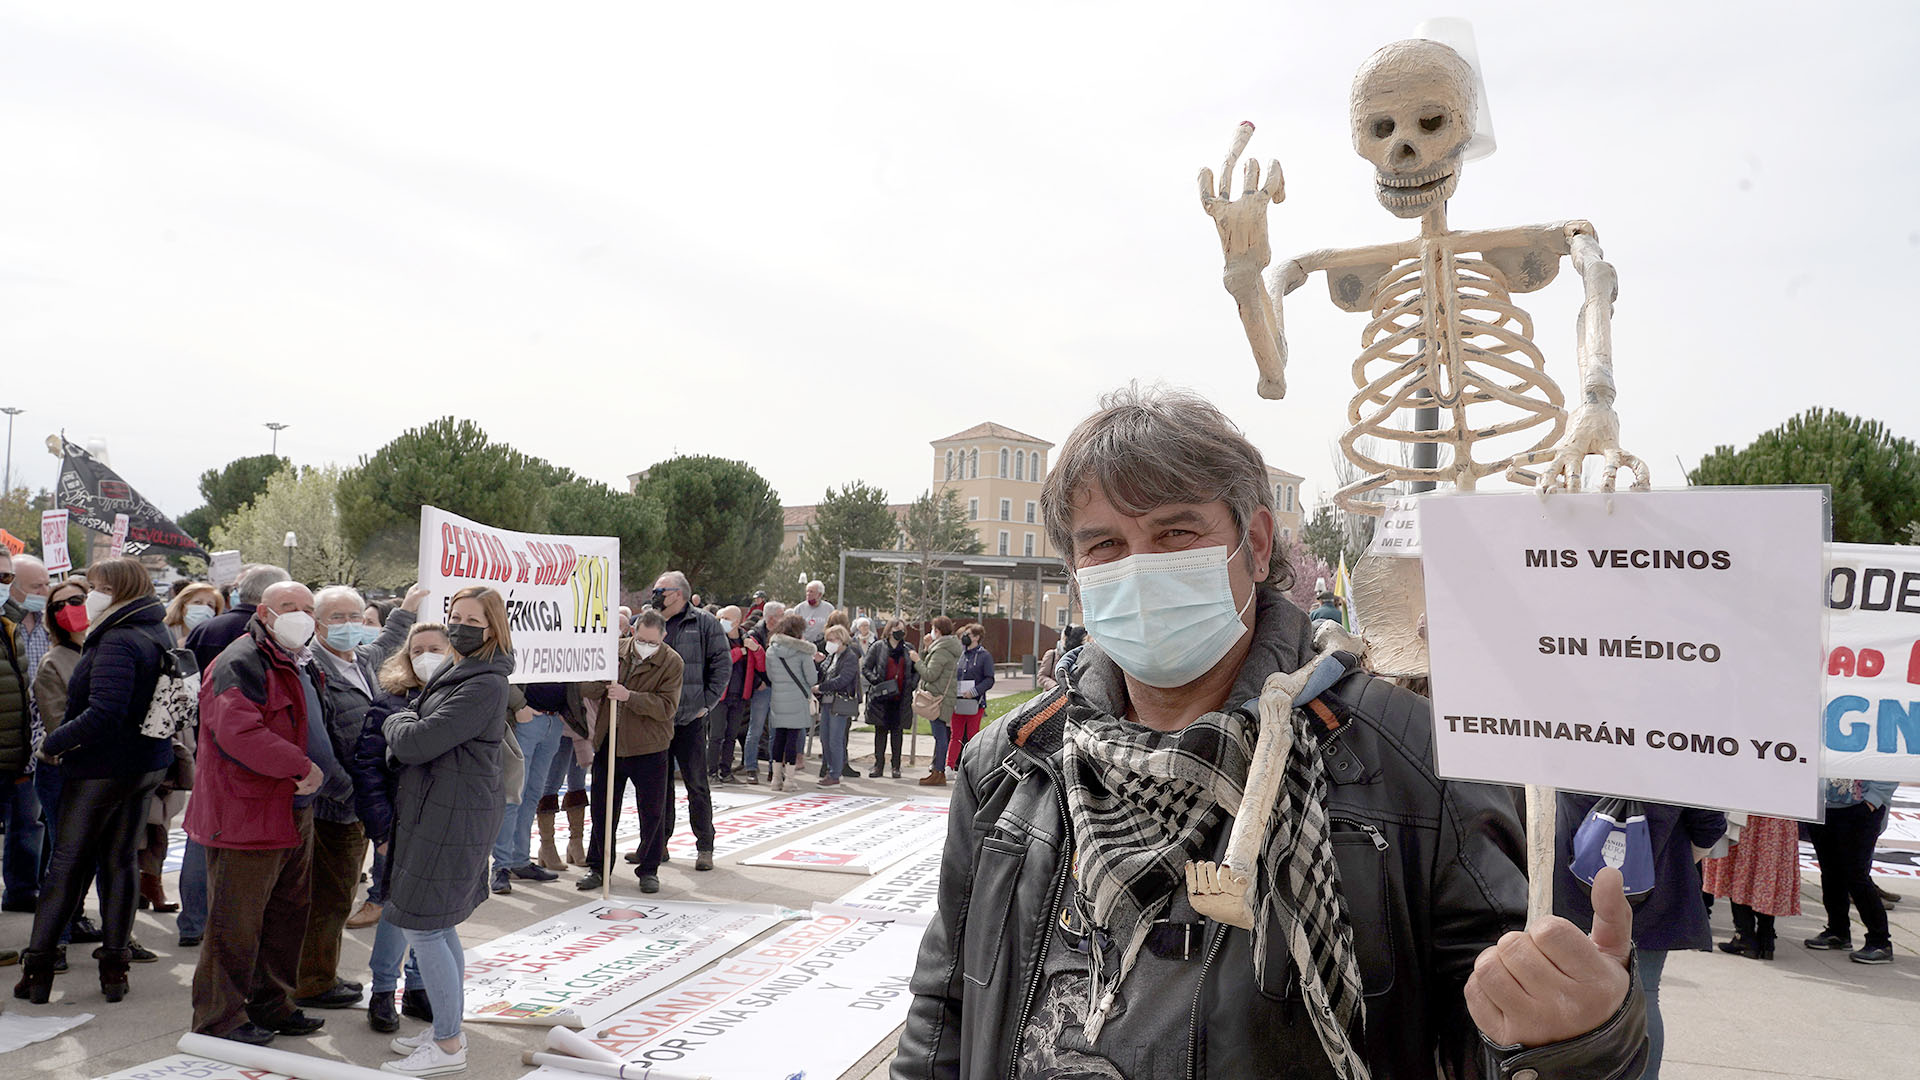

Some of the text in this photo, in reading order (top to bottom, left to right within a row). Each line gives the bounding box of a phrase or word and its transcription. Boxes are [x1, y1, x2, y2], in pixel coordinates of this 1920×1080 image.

[78, 516, 115, 534] #SPAN
[1381, 538, 1403, 547] ME
[440, 522, 577, 586] CENTRO DE SALUD
[1525, 549, 1731, 569] MIS VECINOS
[522, 648, 530, 674] Y
[1538, 635, 1721, 664] SIN MÉDICO
[1821, 646, 1885, 677] AD
[1444, 714, 1808, 763] TERMINARÁN COMO YO.
[864, 853, 942, 901] EN DEFENS
[507, 962, 559, 974] LA
[539, 924, 639, 962] SANIDAD
[697, 977, 745, 987] Y
[723, 958, 787, 977] EL
[755, 914, 852, 959] BIERZO
[529, 990, 582, 1003] LA
[565, 938, 688, 989] CISTÉRNIGA
[571, 996, 603, 1007] EN
[592, 965, 653, 997] DEFENSA
[682, 1009, 759, 1037] UNA
[736, 960, 835, 1007] SANIDAD
[815, 919, 896, 960] PÚBLICA
[817, 982, 853, 990] Y
[180, 1062, 232, 1078] DE
